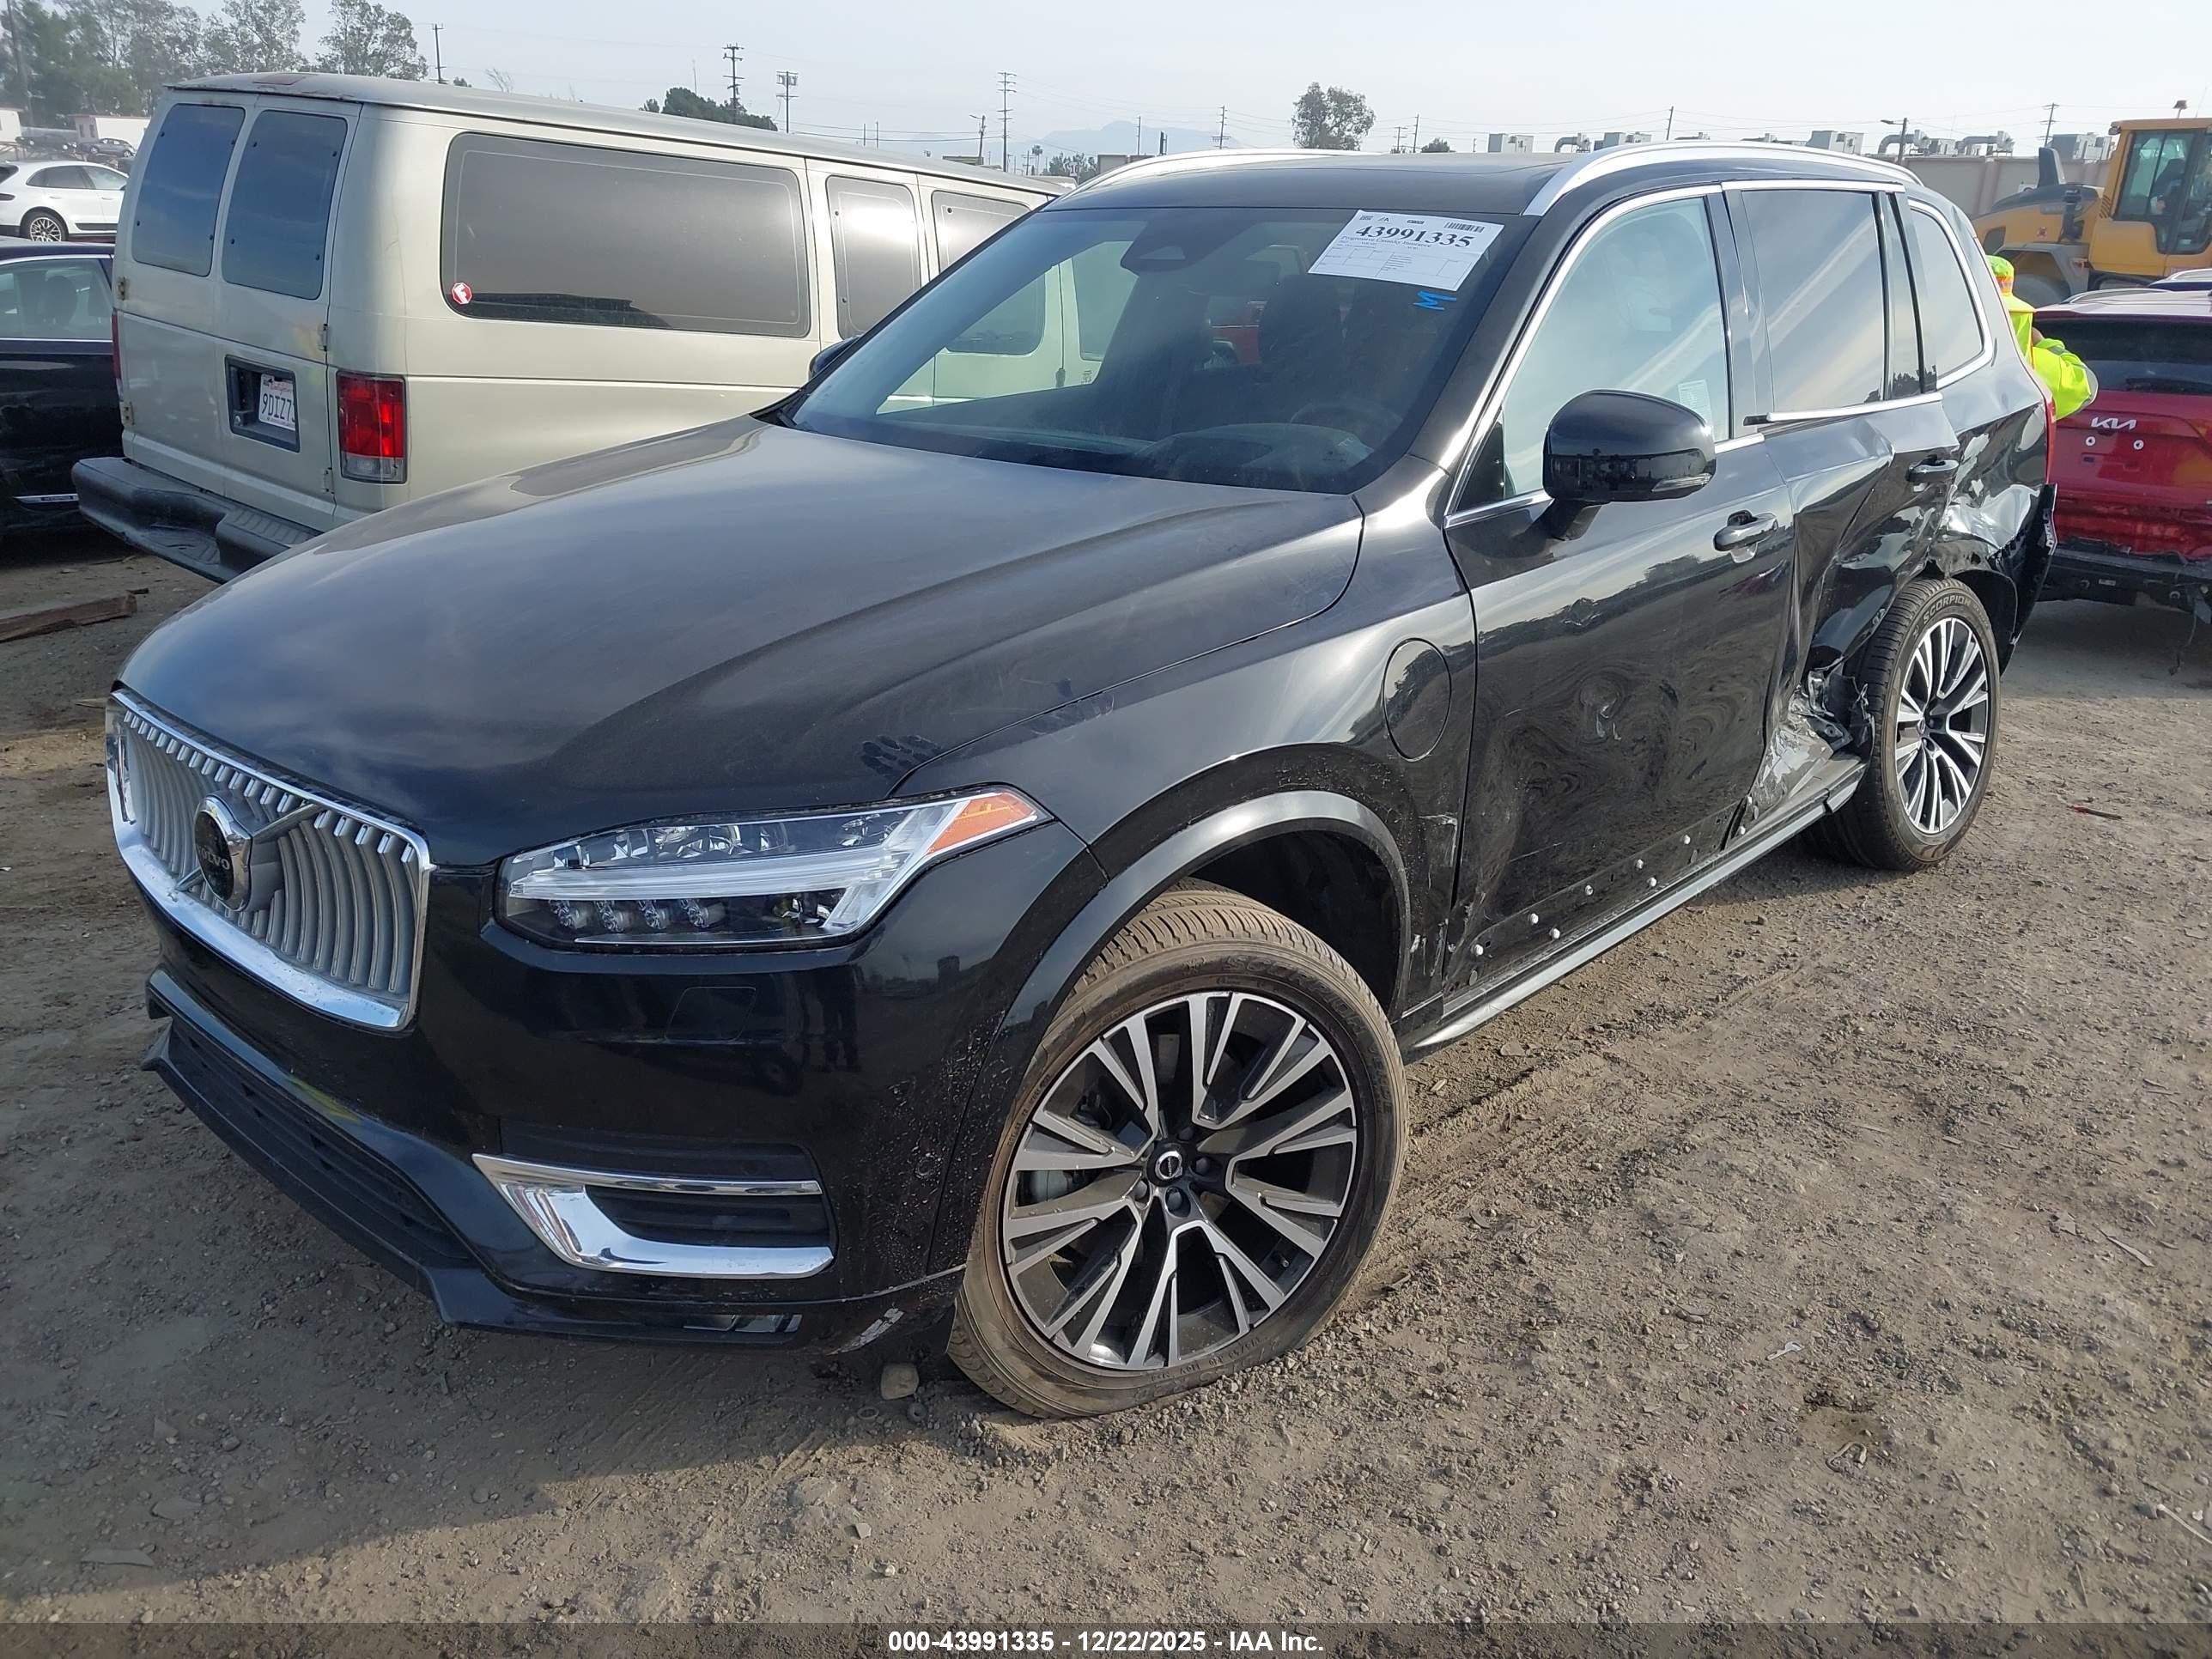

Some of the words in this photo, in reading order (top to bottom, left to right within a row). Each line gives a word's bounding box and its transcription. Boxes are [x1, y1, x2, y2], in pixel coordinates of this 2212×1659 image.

[1356, 225, 1475, 248] 43991335
[2091, 417, 2137, 429] KIA
[1923, 595, 1972, 624] SCORPION
